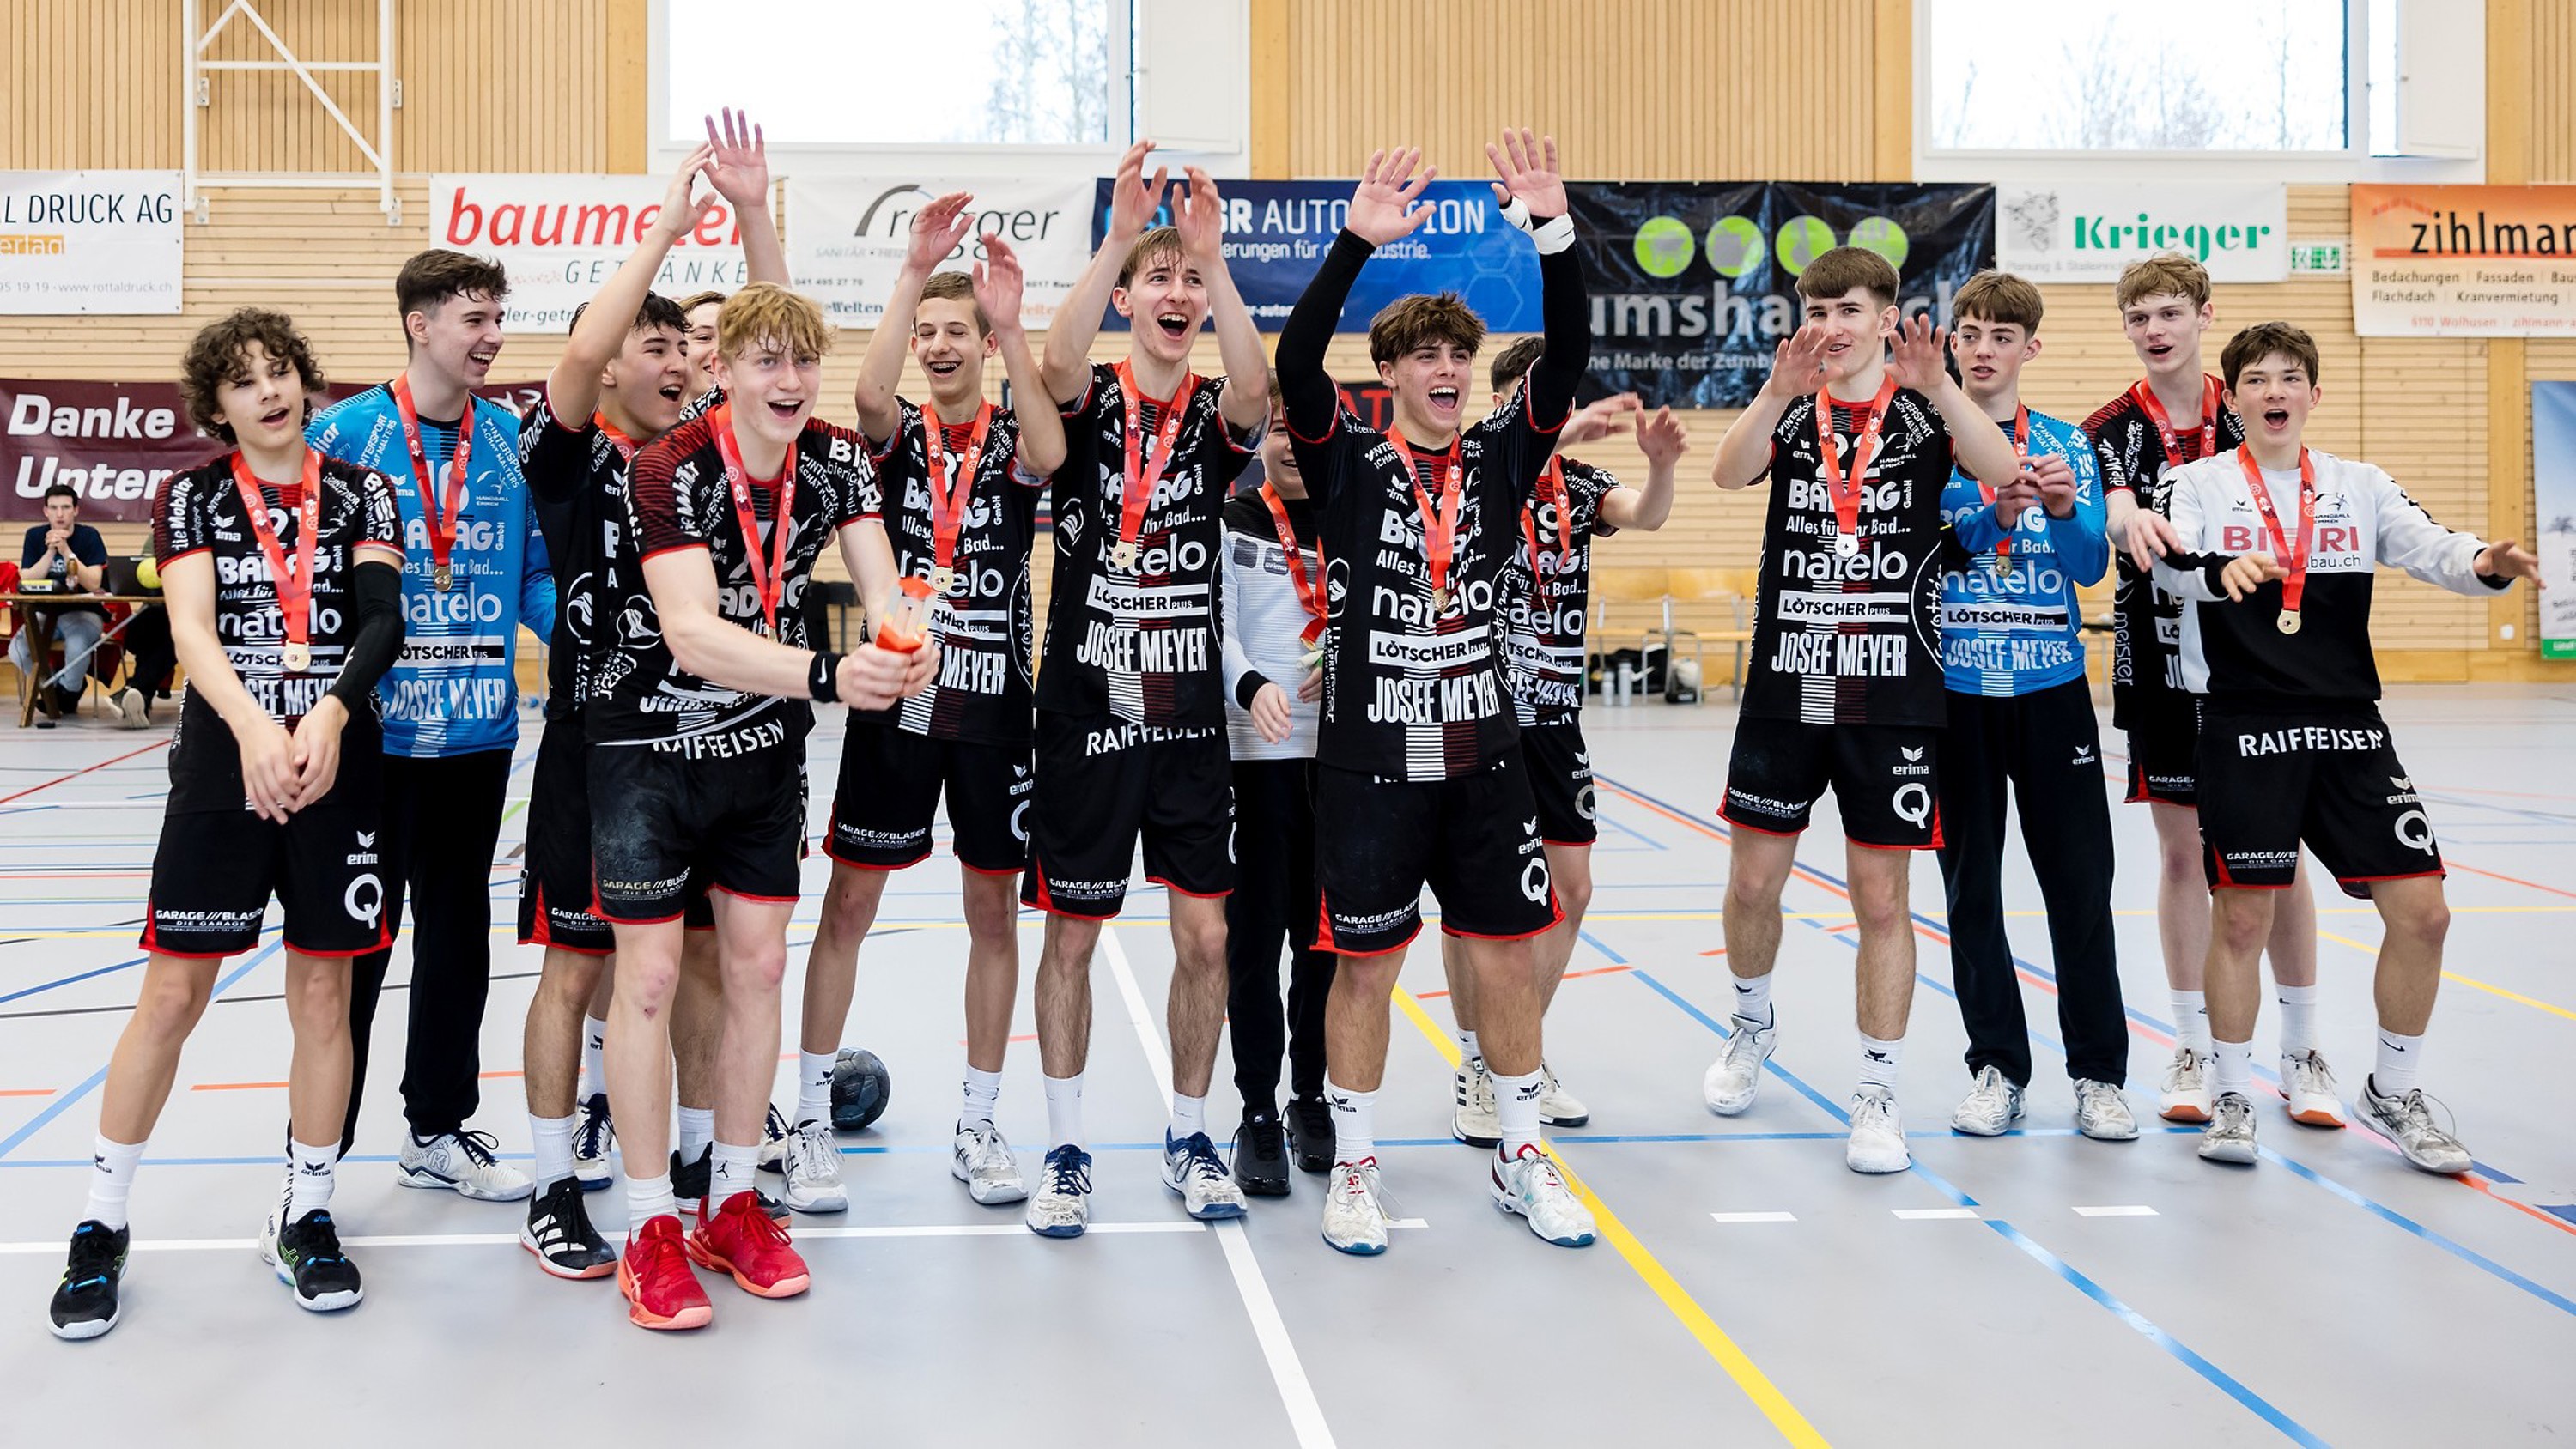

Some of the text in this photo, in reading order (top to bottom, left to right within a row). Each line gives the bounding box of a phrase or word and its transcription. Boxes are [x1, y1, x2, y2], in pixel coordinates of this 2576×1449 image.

[29, 194, 125, 224] DRUCK
[137, 194, 173, 224] AG
[1222, 241, 1291, 263] erungen
[2075, 213, 2271, 264] Krieger
[565, 254, 749, 285] GETÄNKE
[2372, 270, 2460, 286] Bedachungen
[2476, 271, 2535, 283] Fassaden
[2372, 290, 2559, 306] Flachdach Kranvermietung
[1614, 352, 1674, 370] Marke
[1678, 352, 1709, 370] der
[8, 394, 175, 439] Danke
[1194, 463, 1204, 495] GmbH
[1903, 479, 1913, 509] GmbH
[991, 494, 1002, 525] GmbH
[1165, 505, 1206, 529] Bad...
[495, 522, 506, 551] GmbH
[1785, 515, 1819, 535] Alles
[1870, 516, 1911, 535] Bad...
[963, 534, 1005, 554] Bad...
[1376, 549, 1416, 576] Alles
[1782, 540, 1909, 582] natelo
[1171, 599, 1193, 609] PLUS
[1783, 597, 1891, 616] LÖTSCHER PLUS
[1947, 609, 2033, 625] LÖTSCHER
[1076, 620, 1208, 673] JOSEF MEYER
[1376, 640, 1467, 663] LÖTSCHER
[1771, 632, 1909, 677] JOSEF MEYER
[1945, 637, 2074, 671] JOSEF MEYER
[939, 646, 1007, 695] MEYER
[1367, 676, 1436, 724] JOSEF
[1440, 669, 1501, 724] MEYER
[2238, 726, 2384, 757] RAIFFEISEN
[1892, 763, 1930, 776] erima
[2072, 754, 2096, 766] erima
[1892, 782, 1931, 830] Q
[2394, 809, 2435, 857] Q
[1520, 857, 1549, 906] Q
[344, 872, 384, 930] Q
[300, 1168, 331, 1177] erima
